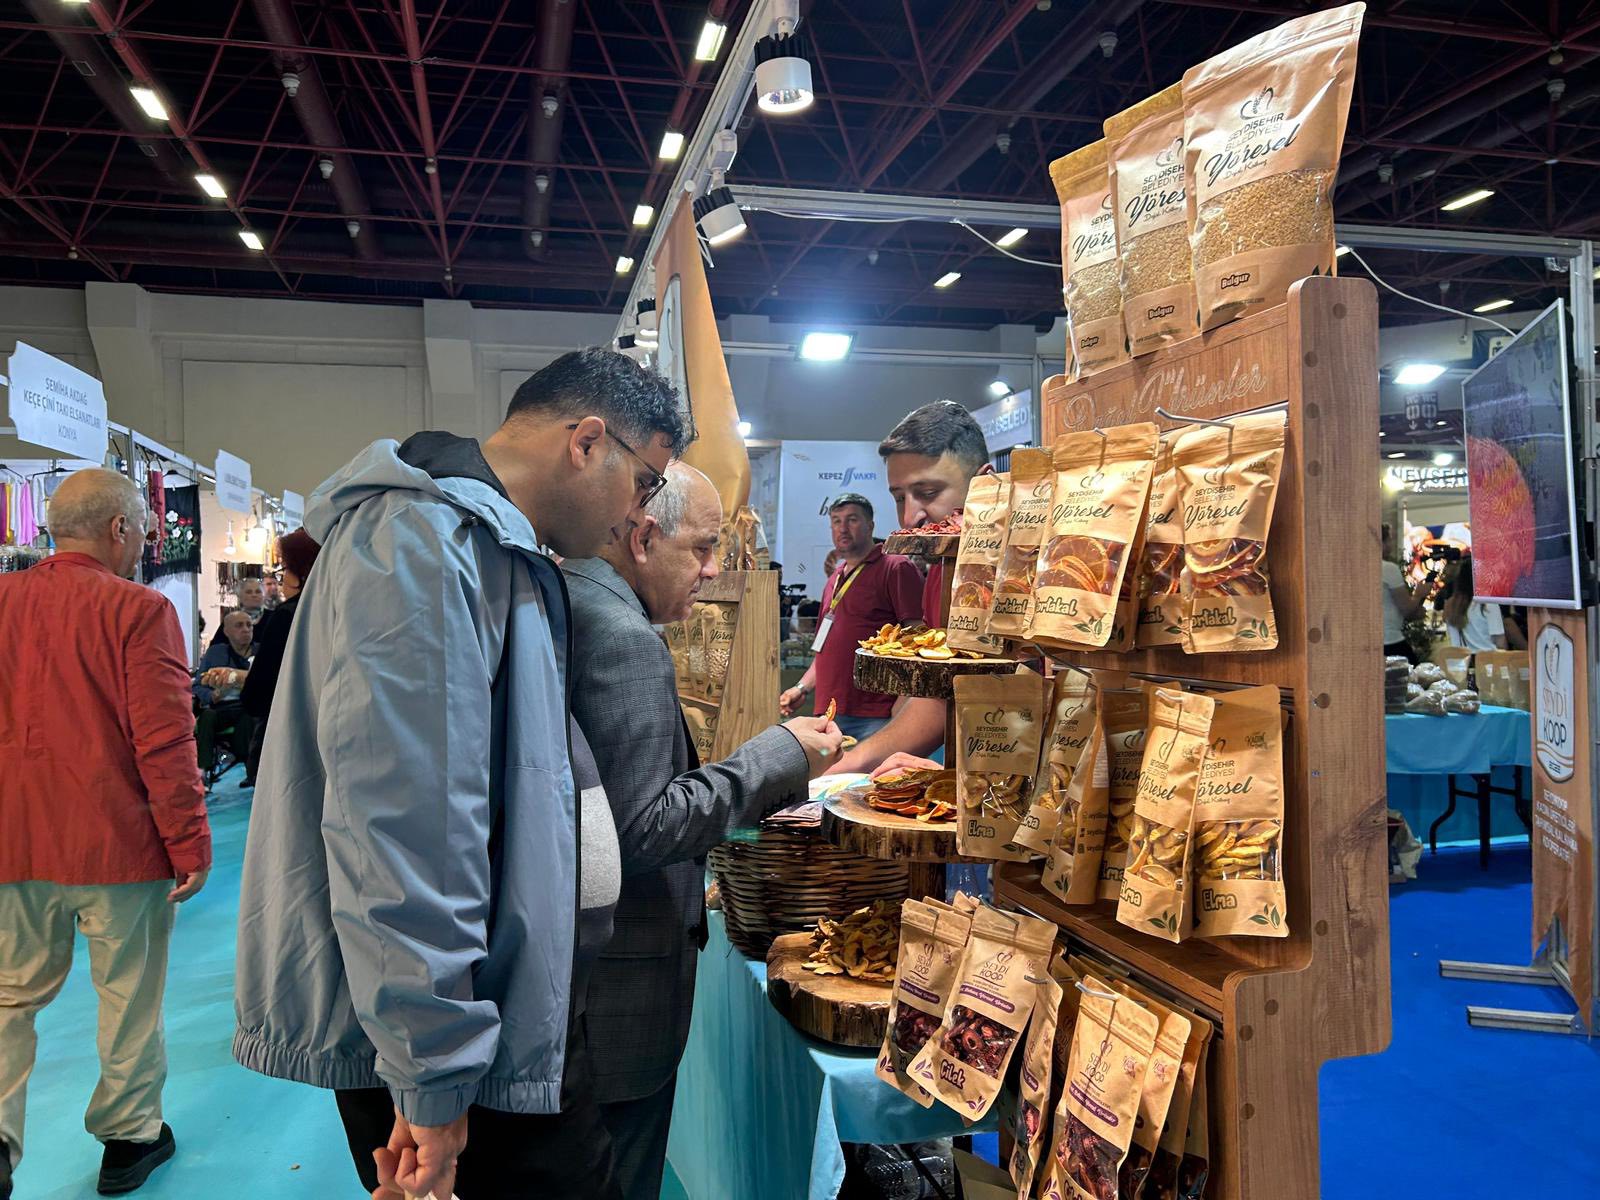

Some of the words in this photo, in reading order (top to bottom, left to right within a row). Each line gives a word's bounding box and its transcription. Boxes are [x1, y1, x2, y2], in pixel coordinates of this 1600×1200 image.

[1204, 123, 1300, 187] Yöresel
[1142, 173, 1184, 194] BELEDİYE
[1143, 164, 1184, 185] SEYDİŞEH
[1125, 187, 1186, 228] Yöres
[1221, 273, 1250, 289] Bulgur
[1148, 305, 1175, 320] Bulgur
[45, 377, 68, 398] SEMİHA
[24, 389, 41, 408] KEÇE
[42, 394, 55, 412] ÇİNİ
[56, 401, 69, 416] TAKI
[58, 424, 77, 440] KONYA
[818, 472, 843, 480] KEPEZ
[1010, 510, 1047, 526] Yörese
[1052, 504, 1115, 527] Yöresel
[1185, 499, 1248, 531] Yöresel
[993, 597, 1028, 615] ortakal
[1036, 596, 1078, 616] ortakal
[950, 615, 979, 632] ortakal
[1192, 606, 1237, 628] ortakal
[1542, 687, 1568, 720] SEYDİ
[1055, 734, 1088, 749] resel
[1543, 717, 1568, 749] KOOP
[967, 736, 1019, 757] Yöresel
[1201, 769, 1236, 779] LEDİYESİ
[1202, 760, 1235, 770] YDİŞEHİR
[1137, 771, 1177, 800] Yöresel
[1198, 776, 1253, 798] öresel
[968, 819, 996, 838] Elma
[1202, 888, 1238, 911] Elma
[914, 964, 929, 975] KOOP
[980, 968, 1004, 981] KOOP
[1085, 1063, 1104, 1083] KOOP
